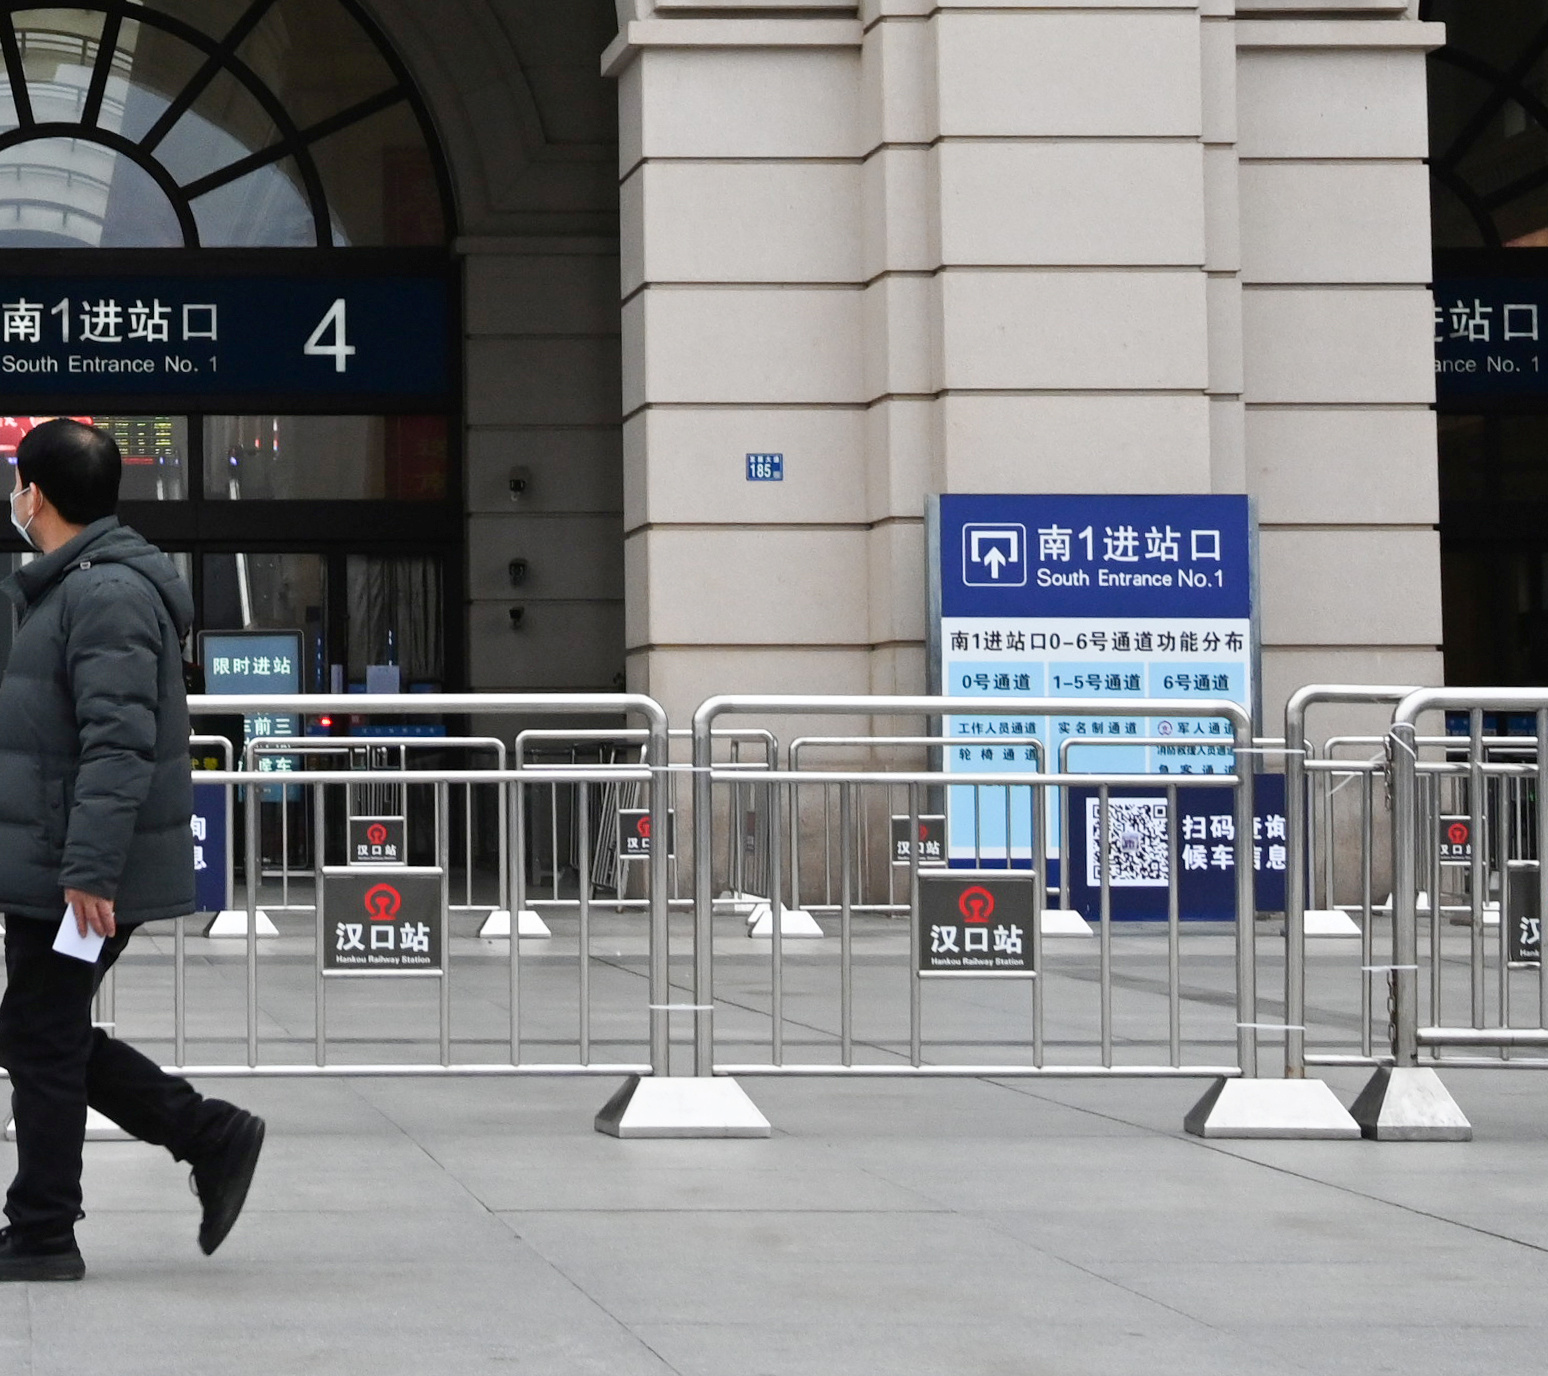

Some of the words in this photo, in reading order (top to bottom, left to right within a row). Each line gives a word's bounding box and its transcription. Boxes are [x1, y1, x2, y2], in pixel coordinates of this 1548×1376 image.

[2, 298, 219, 343] 南1进站口
[304, 298, 356, 373] 4
[2, 355, 59, 373] South
[68, 355, 157, 373] Entrance
[164, 355, 199, 373] No.
[210, 355, 218, 372] 1
[1487, 355, 1521, 373] No.
[1531, 355, 1539, 372] 1
[750, 463, 771, 478] 185
[1037, 524, 1222, 562] 南1进站口
[1037, 569, 1090, 588] South
[1098, 569, 1172, 588] Entrance
[212, 656, 292, 676] 限时进站
[961, 673, 1031, 691] 0号通道
[1163, 673, 1230, 691] 6号通道
[958, 721, 1037, 735] 工作人员通道
[1058, 721, 1138, 735] 实名制通道
[357, 844, 397, 856] 汉口站
[335, 921, 431, 952] 汉口站
[930, 924, 1024, 954] 汉口站
